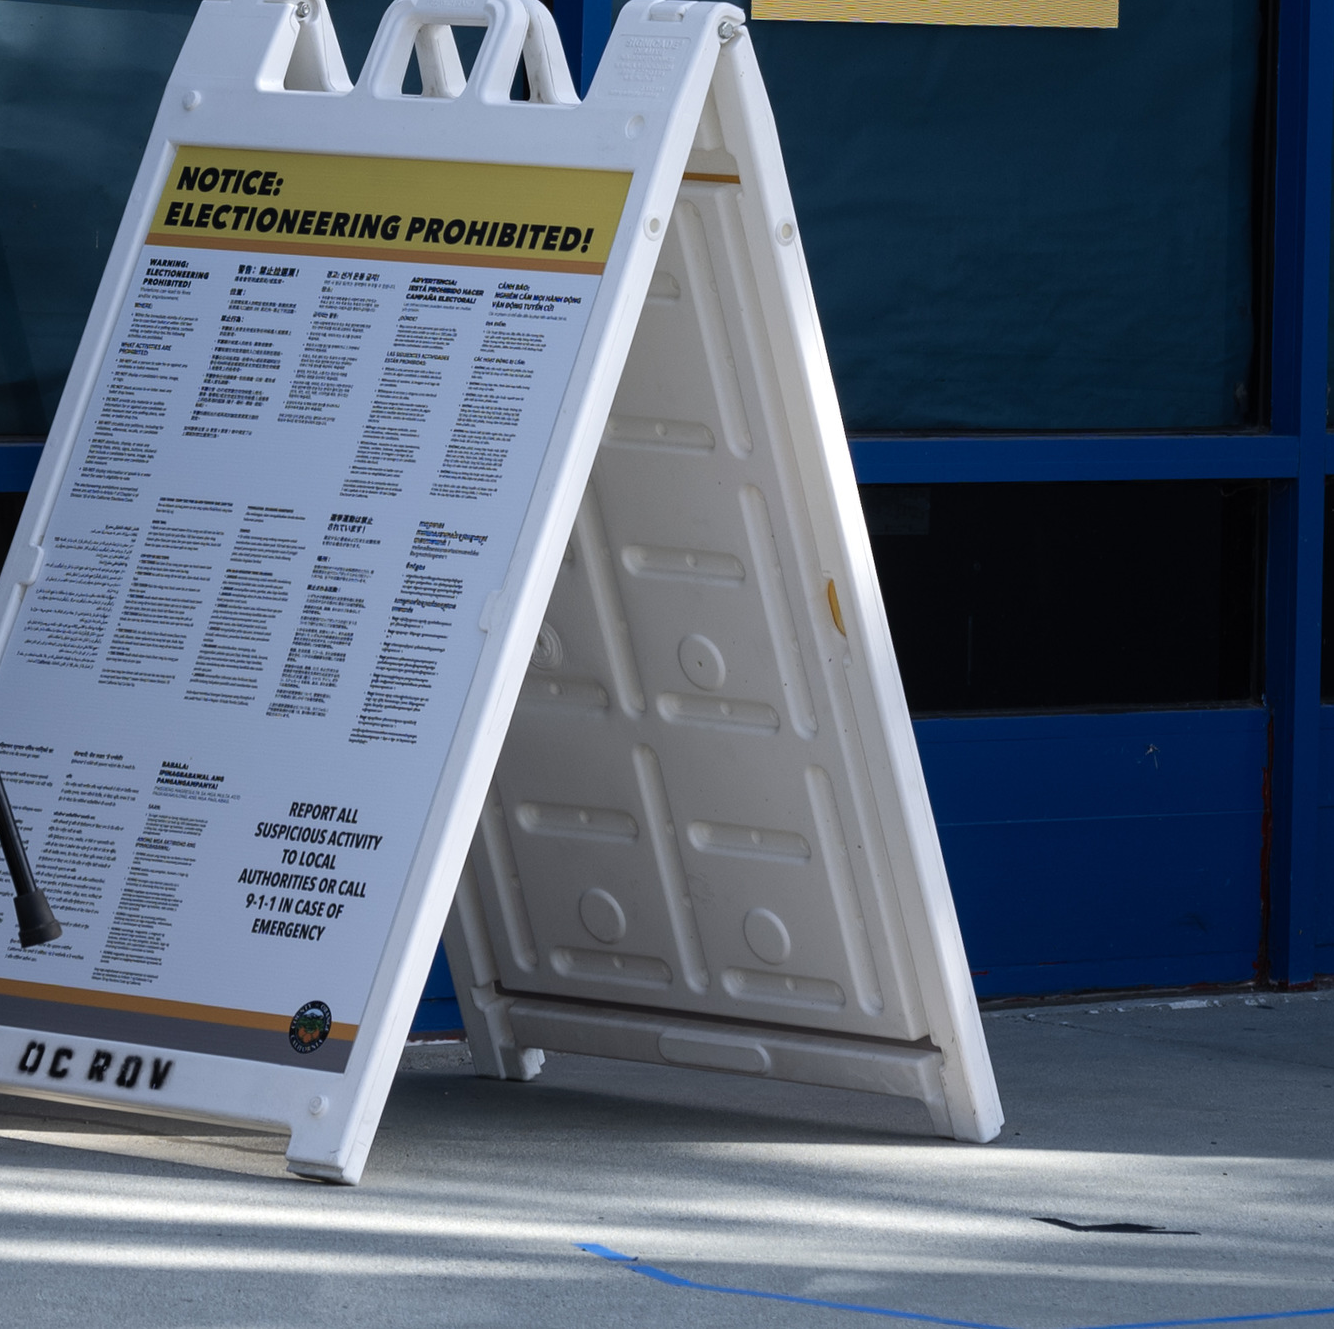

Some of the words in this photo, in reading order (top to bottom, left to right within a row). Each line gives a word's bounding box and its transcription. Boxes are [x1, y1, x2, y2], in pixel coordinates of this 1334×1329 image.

[175, 166, 284, 197] NOTICE:
[164, 202, 401, 242] ELECTIONEERING
[405, 217, 594, 254] PROHIBITED!
[145, 268, 209, 280] ELECTIONEERING
[148, 258, 189, 269] WARNING:
[142, 278, 191, 289] PROHIBITED!
[288, 801, 338, 822] REPORT
[336, 808, 358, 824] ALL
[254, 822, 327, 845] SUSPICIOUS
[327, 830, 383, 851] ACTIVITY
[281, 849, 298, 865] TO
[298, 851, 336, 870] LOCAL
[237, 868, 318, 892] AUTHORITIES
[318, 877, 337, 894] OR
[338, 880, 366, 898] CALL
[245, 893, 277, 912] 9-1-1
[278, 897, 294, 913] IN
[294, 899, 326, 917] CASE
[326, 903, 345, 919] OF
[251, 918, 326, 942] EMERGENCY
[18, 1040, 74, 1079] OC
[87, 1048, 175, 1091] ROV
